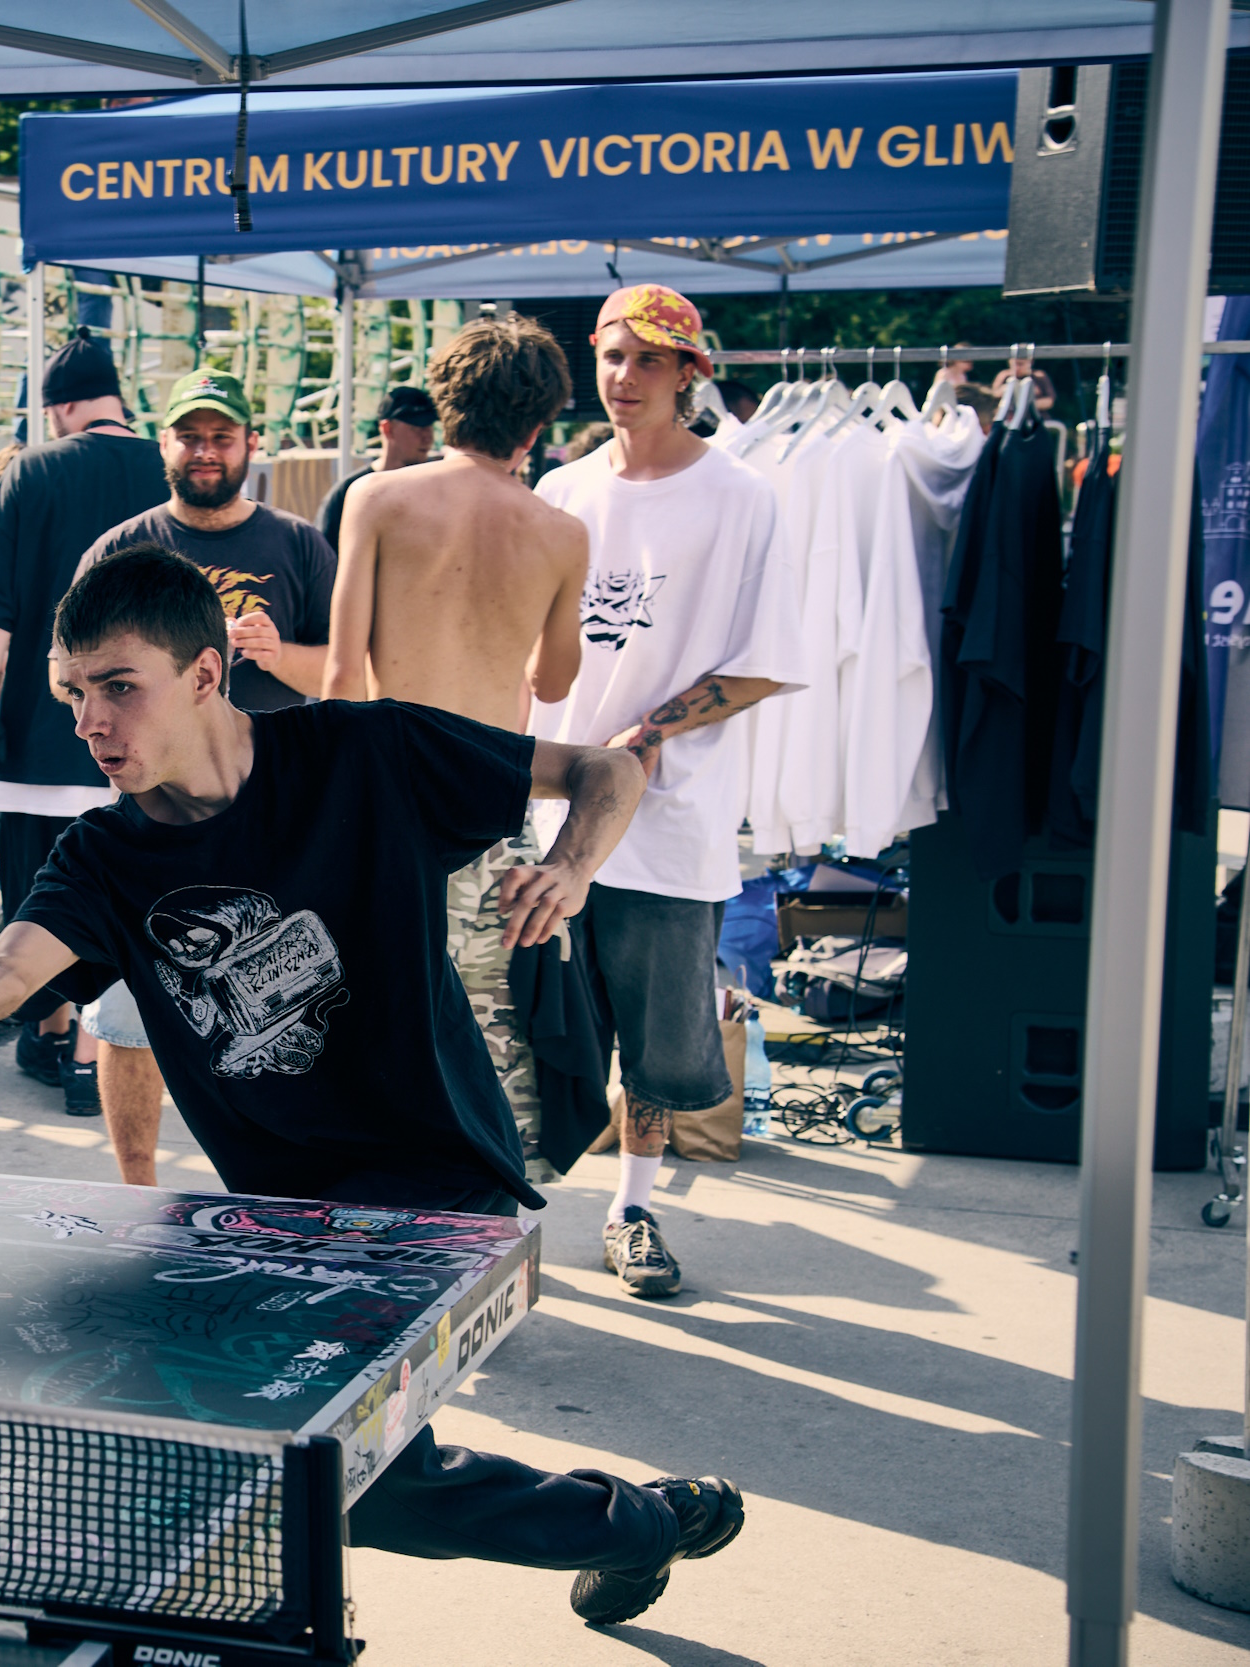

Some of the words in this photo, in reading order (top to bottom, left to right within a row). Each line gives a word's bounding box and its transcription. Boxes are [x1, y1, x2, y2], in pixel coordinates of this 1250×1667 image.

[59, 154, 290, 202] CENTRUM
[302, 140, 521, 192] KULTURY
[539, 129, 791, 178] VICTORIA
[806, 126, 864, 171] W
[457, 1281, 516, 1374] DONIC
